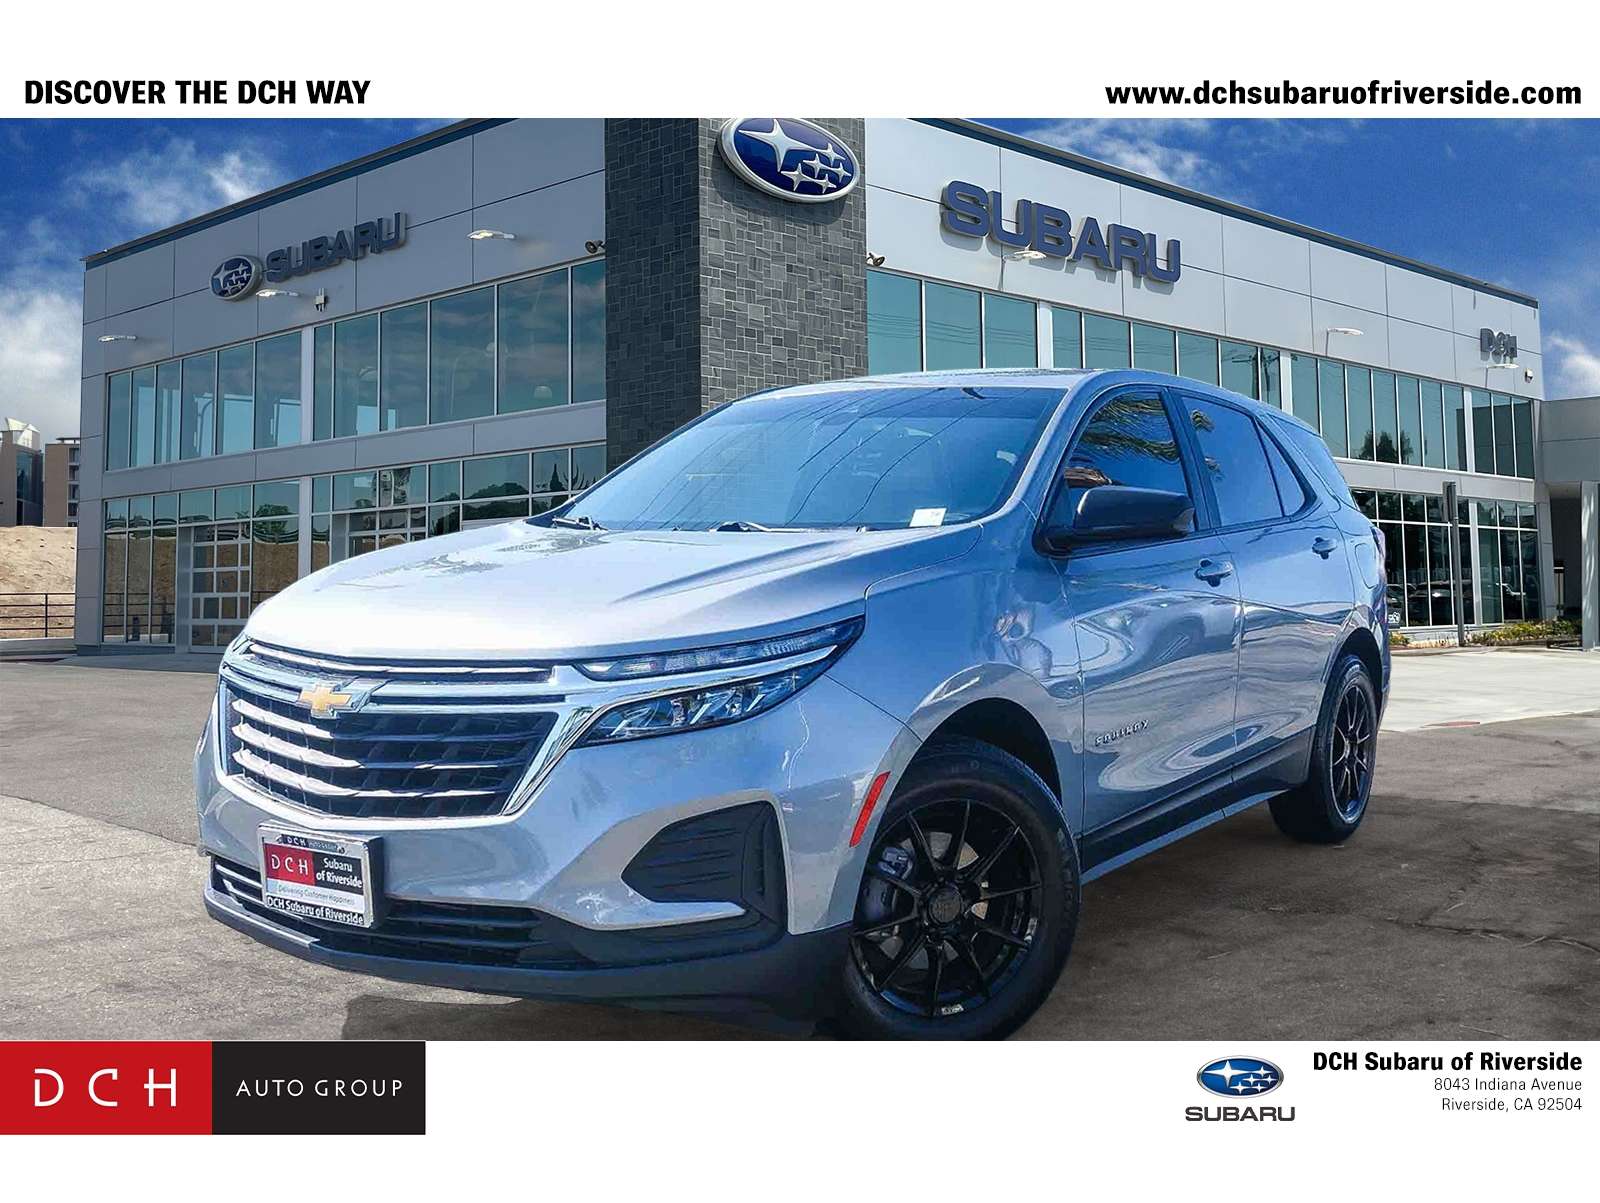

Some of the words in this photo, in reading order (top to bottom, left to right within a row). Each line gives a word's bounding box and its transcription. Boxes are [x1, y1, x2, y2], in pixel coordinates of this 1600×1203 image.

[941, 180, 1181, 283] SUBARU
[266, 211, 407, 283] SUBARU
[1480, 328, 1518, 363] DCH
[270, 854, 309, 876] DCH
[316, 870, 326, 881] of
[326, 871, 363, 889] Riverside
[323, 857, 353, 873] Subaru
[267, 896, 285, 909] DCH
[285, 900, 315, 915] Subaru
[315, 907, 324, 918] of
[325, 908, 364, 926] Riverside
